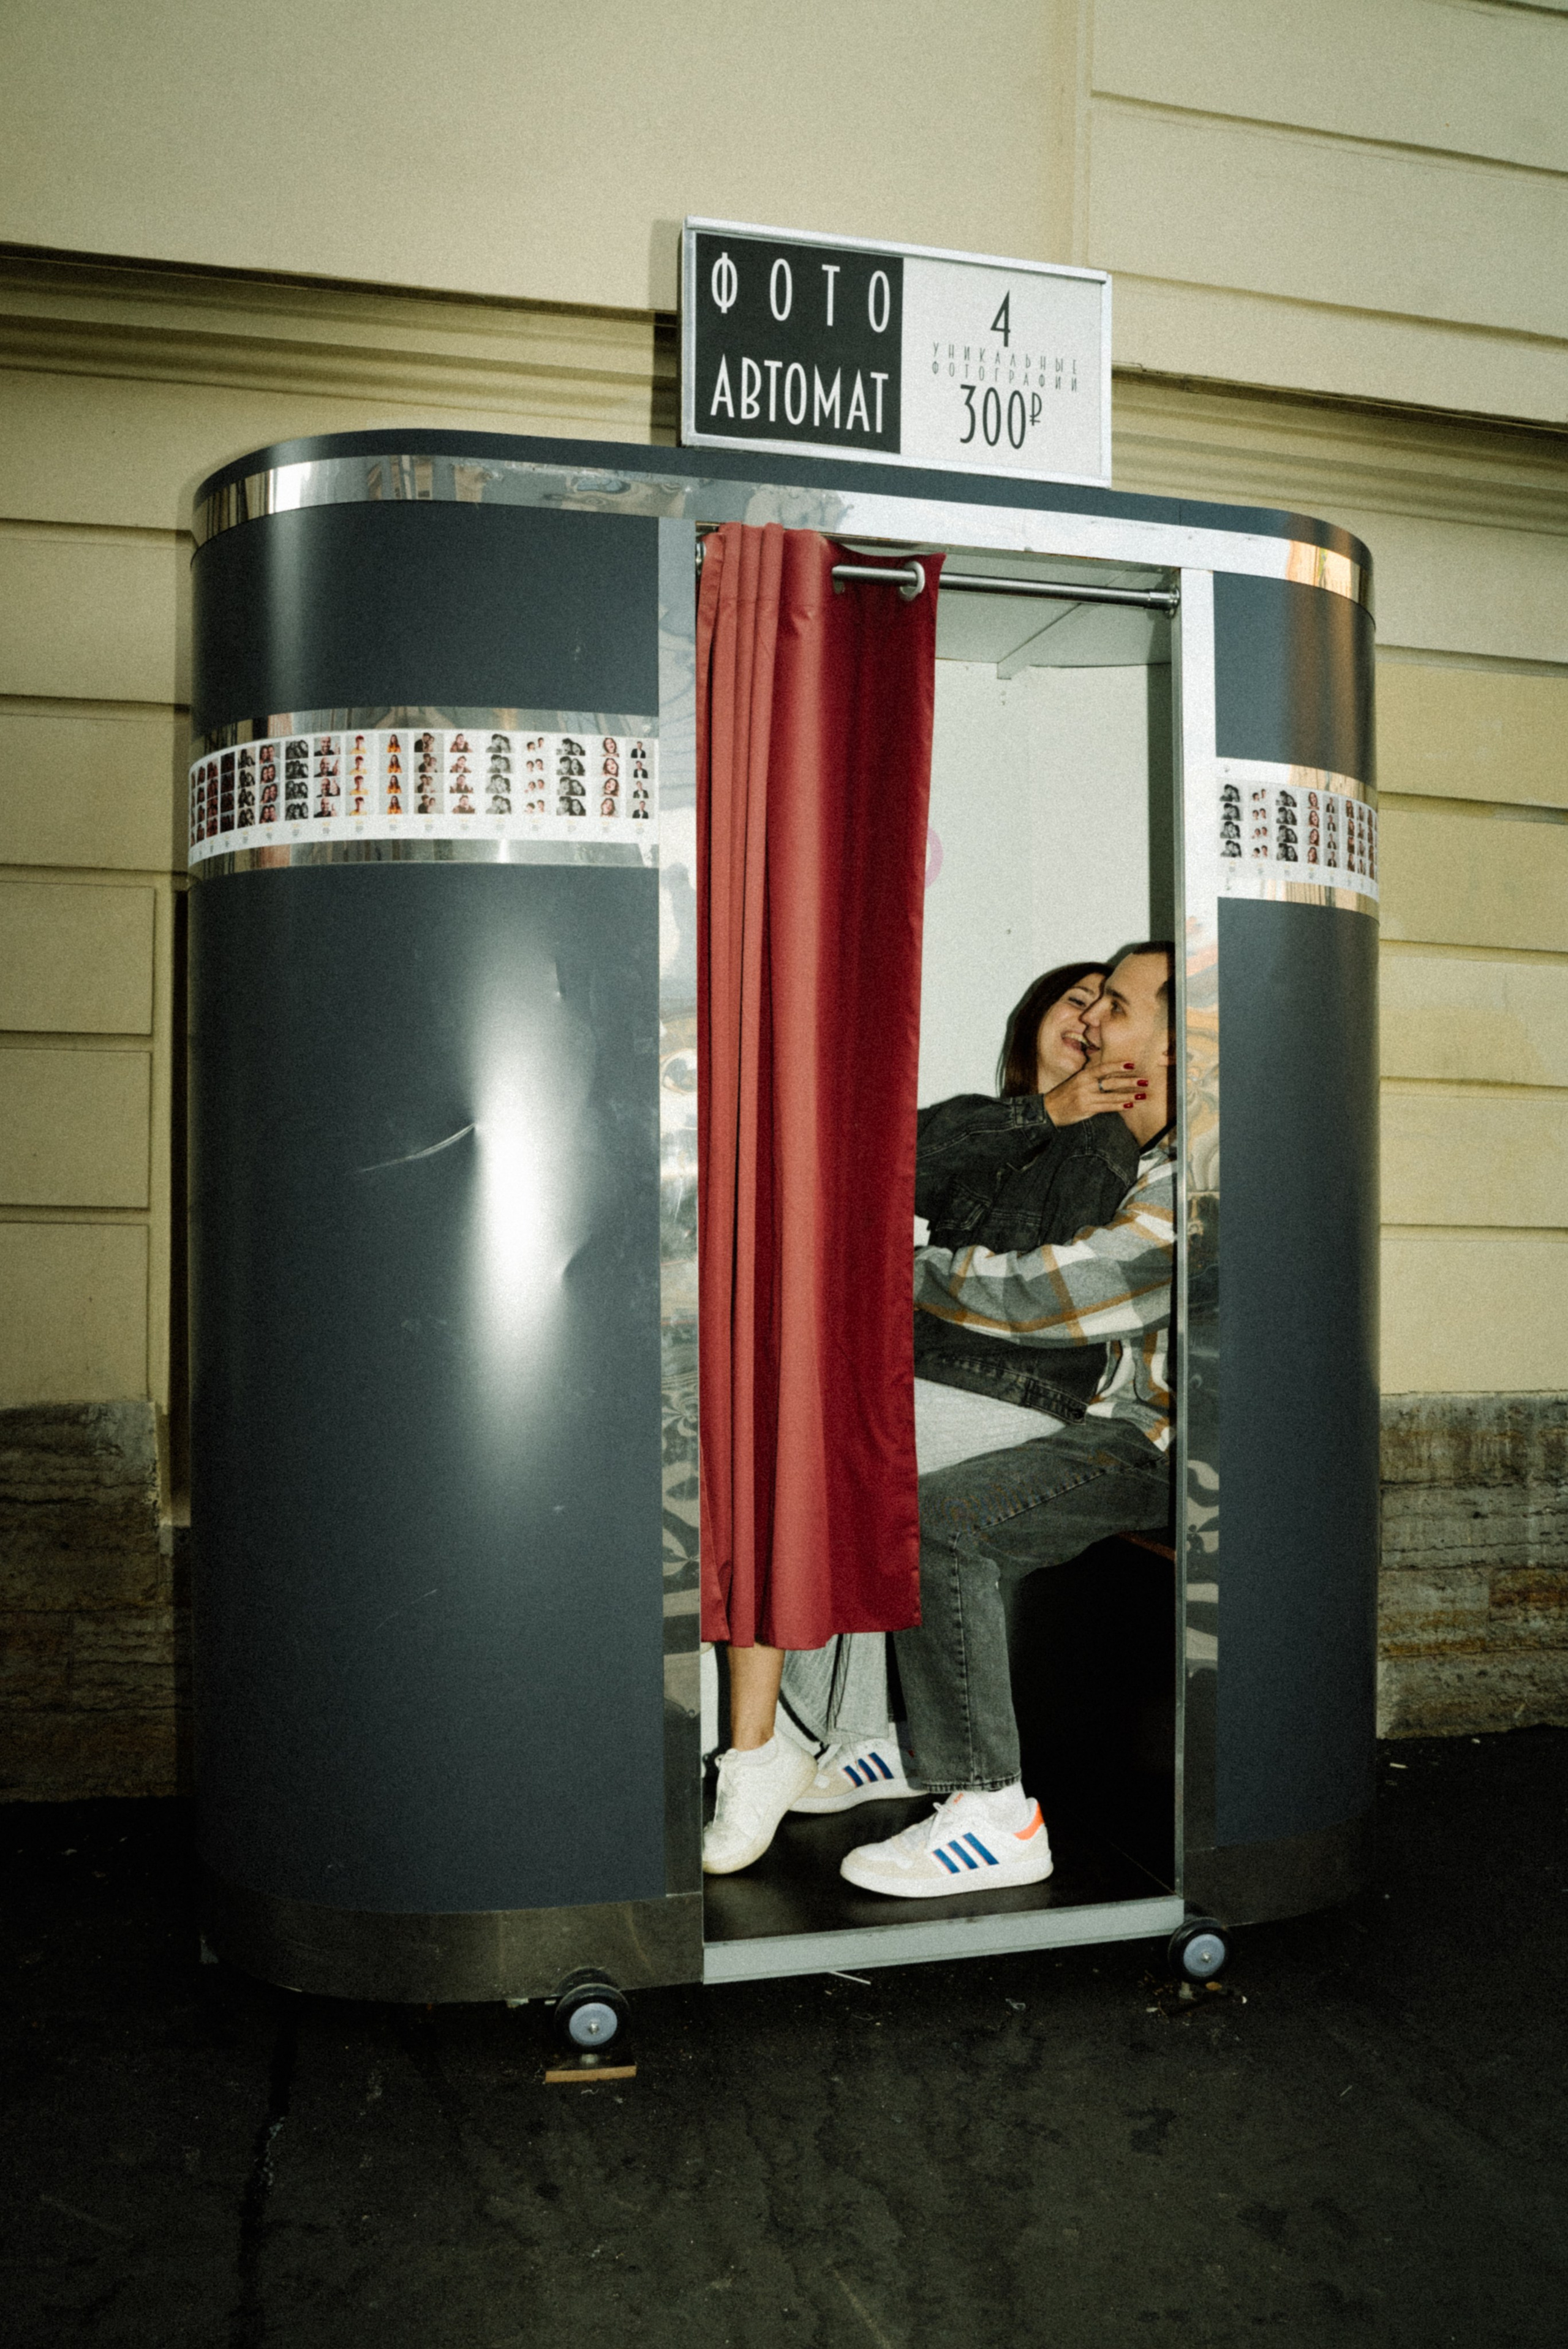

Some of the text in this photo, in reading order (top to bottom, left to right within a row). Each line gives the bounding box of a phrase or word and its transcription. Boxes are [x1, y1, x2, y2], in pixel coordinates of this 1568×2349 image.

[711, 252, 891, 333] ФОТО
[990, 289, 1011, 348] 4
[932, 360, 1077, 392] ФОТОГРАФИИ
[933, 342, 1077, 374] УНИКАЛЬНЫЕ
[710, 354, 889, 433] АВТОМАТ
